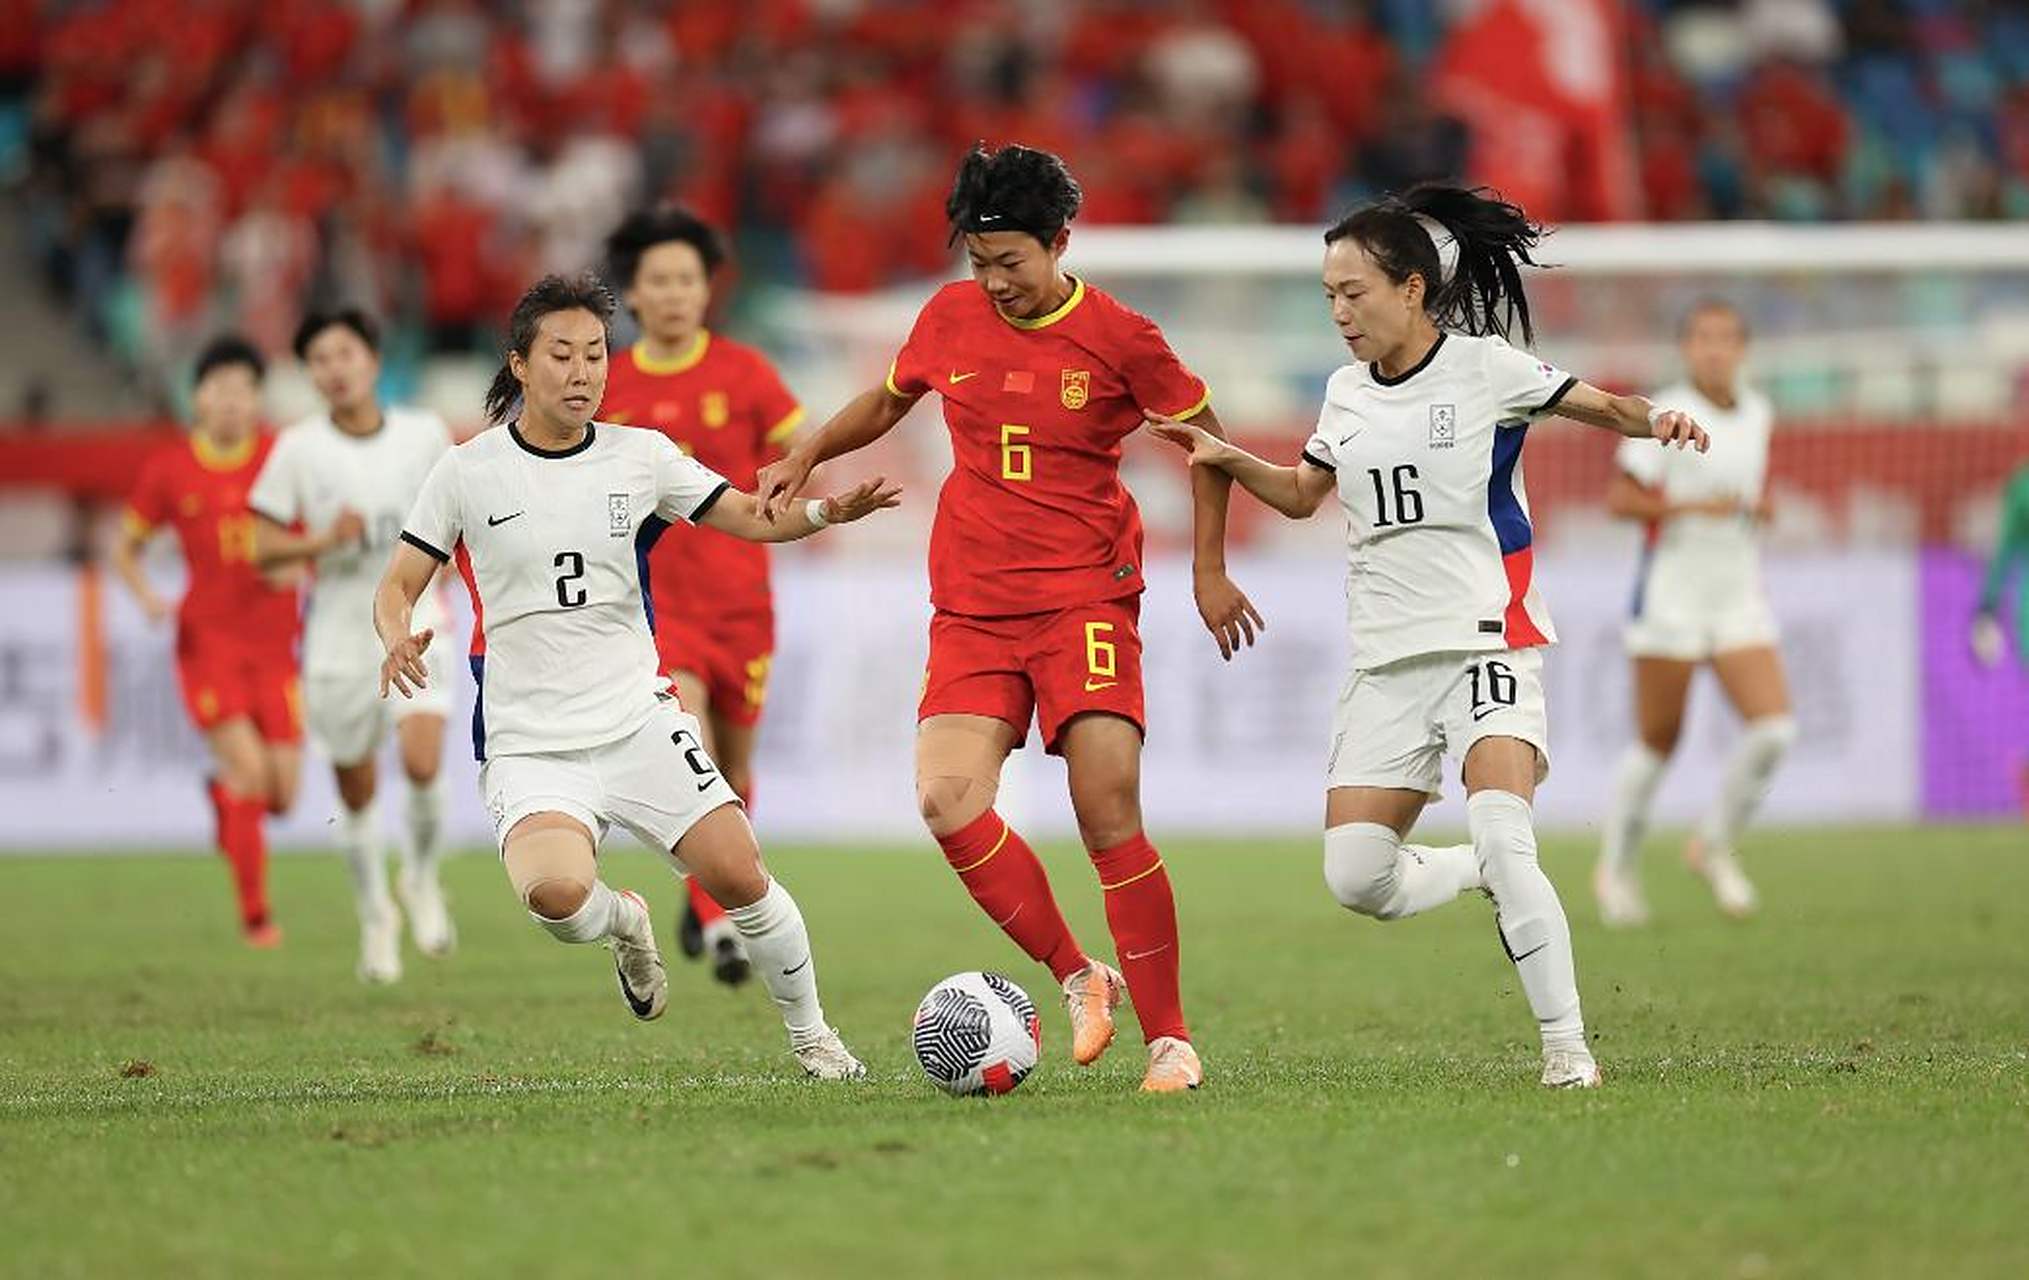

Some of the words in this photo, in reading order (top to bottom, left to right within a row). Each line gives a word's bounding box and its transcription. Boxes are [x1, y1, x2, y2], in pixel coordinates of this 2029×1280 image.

[1001, 424, 1032, 481] 6
[1368, 464, 1425, 528] 16
[553, 551, 588, 608] 2
[1085, 621, 1117, 678] 6
[1465, 660, 1518, 713] 16
[670, 730, 715, 775] 2
